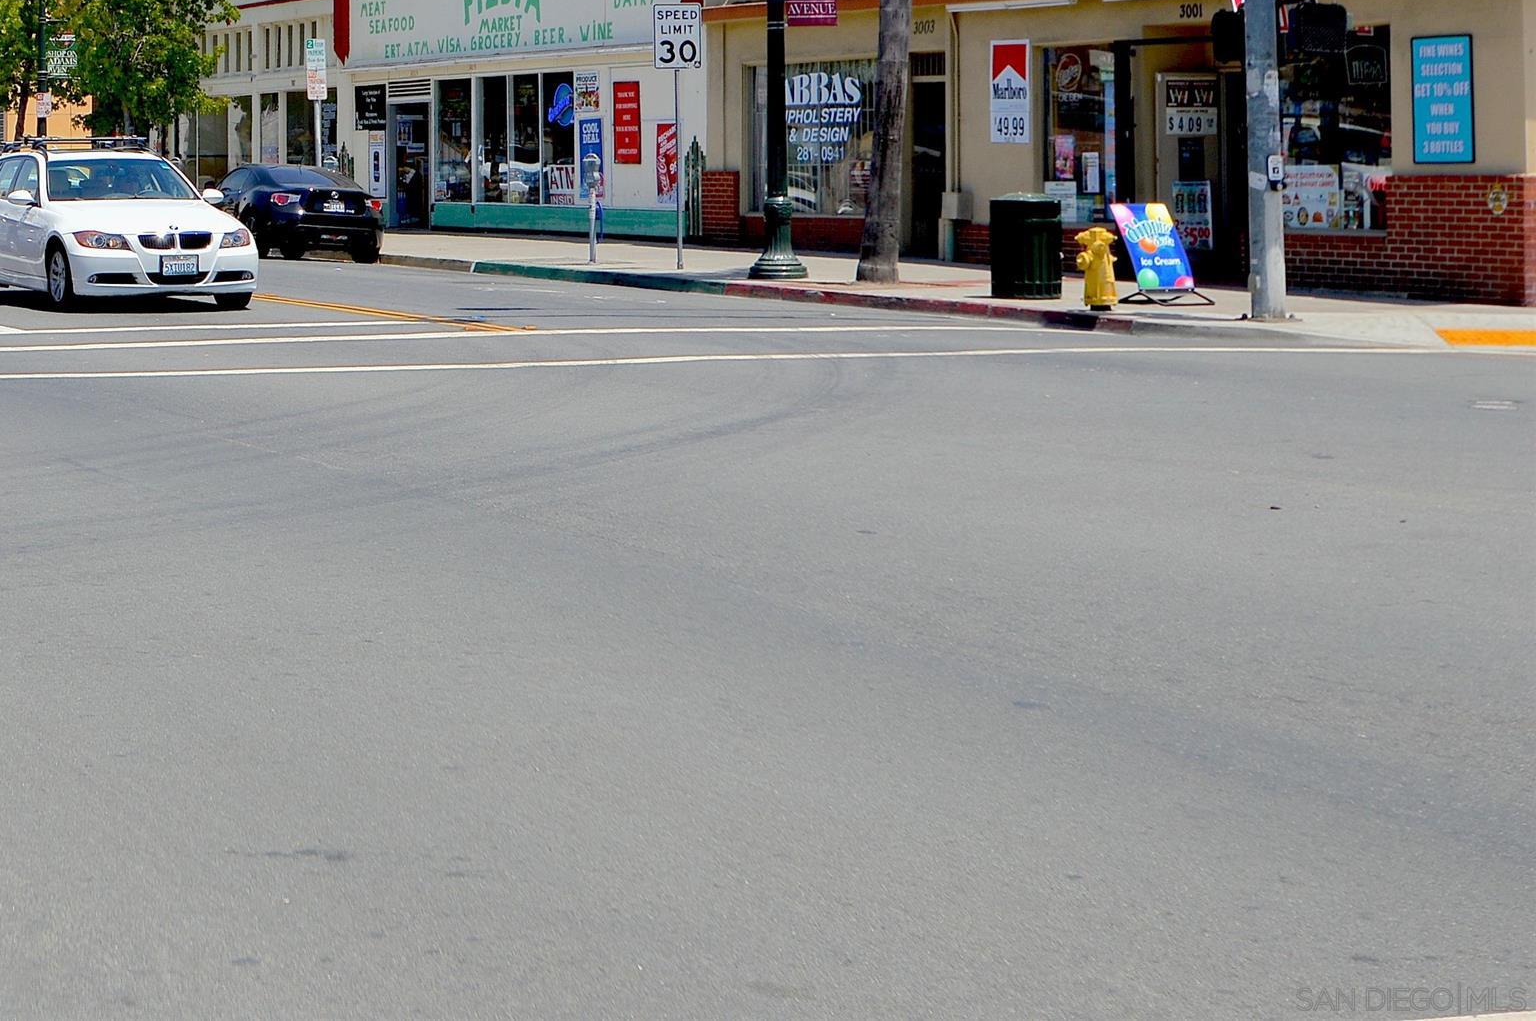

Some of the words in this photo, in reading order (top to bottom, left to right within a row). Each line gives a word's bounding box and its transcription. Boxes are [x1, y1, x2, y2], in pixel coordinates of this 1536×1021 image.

[360, 1, 386, 18] MEAT
[656, 10, 698, 21] SPEED
[787, 2, 837, 15] AVENUE
[1179, 2, 1203, 19] 3001
[368, 15, 415, 35] SEAFOOD
[478, 14, 523, 35] MARKET
[579, 19, 614, 42] WINE
[660, 25, 694, 35] LIMIT
[913, 19, 936, 35] 3003
[658, 39, 697, 64] 30
[48, 57, 78, 65] ADAMS
[47, 66, 68, 74] AVEN
[1420, 62, 1463, 77] SELECTION
[992, 79, 1027, 100] Marlboro
[1414, 82, 1431, 98] GET
[1433, 81, 1452, 97] 10%
[1453, 81, 1470, 96] OFF
[582, 122, 600, 133] COOL
[789, 128, 798, 142] &
[802, 127, 849, 142] DESIGN
[582, 133, 600, 144] DEAL
[550, 195, 574, 206] INSID
[1140, 257, 1153, 266] Ice
[1153, 257, 1182, 266] Cream
